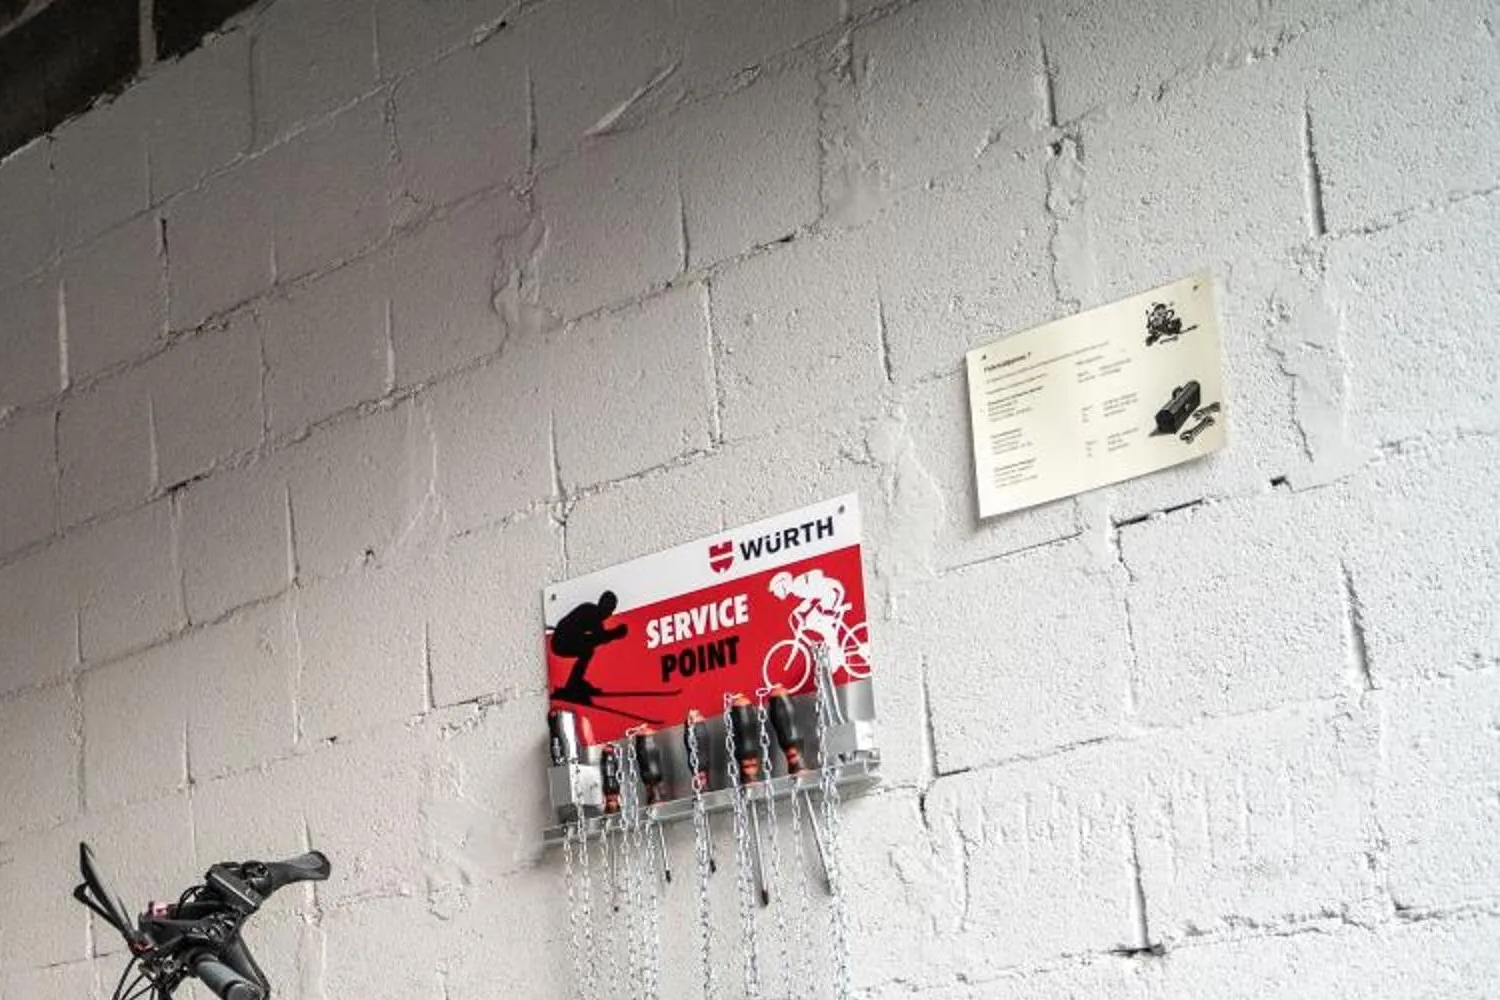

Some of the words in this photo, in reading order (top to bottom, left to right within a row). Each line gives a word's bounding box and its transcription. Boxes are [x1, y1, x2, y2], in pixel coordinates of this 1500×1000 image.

[740, 516, 834, 560] WÜRTH
[646, 594, 749, 649] SERVICE
[661, 636, 739, 683] POINT
